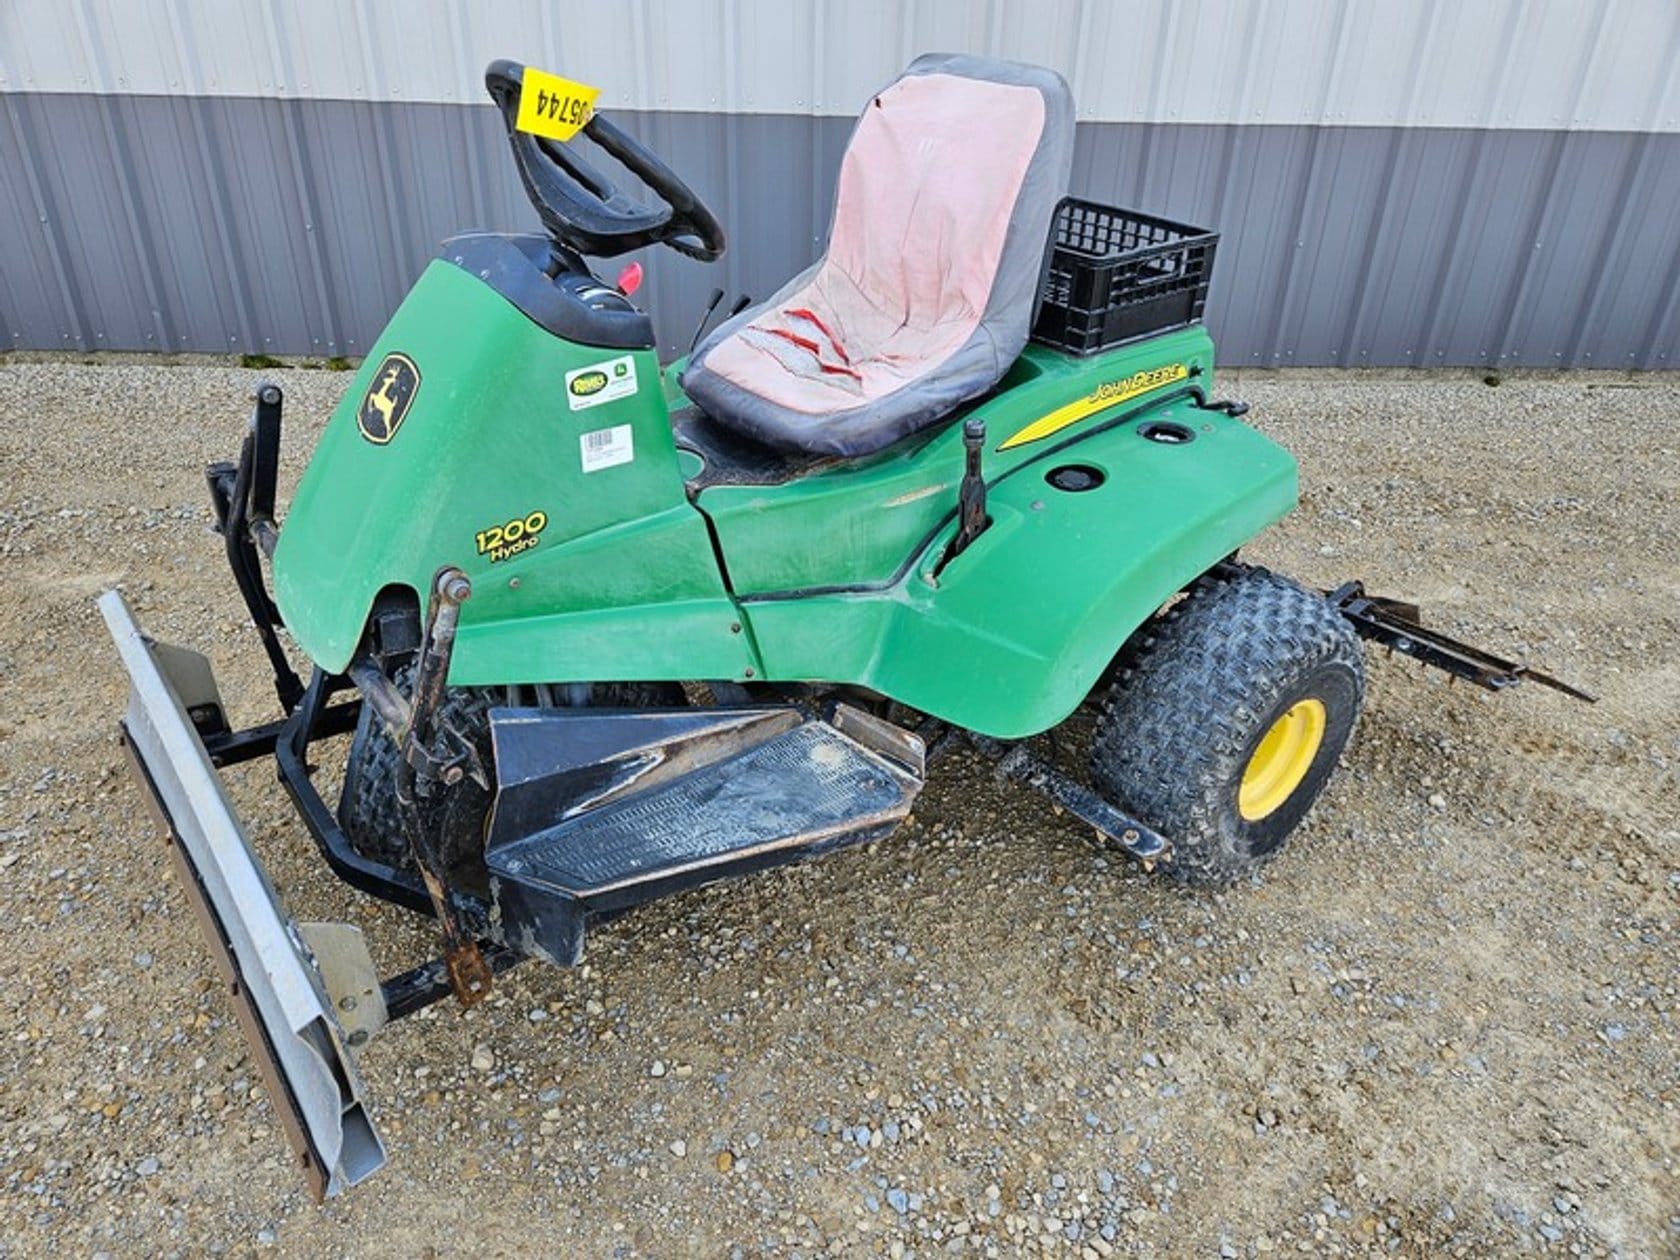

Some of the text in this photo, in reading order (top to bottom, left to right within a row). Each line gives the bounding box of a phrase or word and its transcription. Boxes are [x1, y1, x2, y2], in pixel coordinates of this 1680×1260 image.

[1088, 363, 1181, 403] JOHN DEERE
[475, 511, 548, 555] 1200
[490, 536, 540, 564] Hydro
